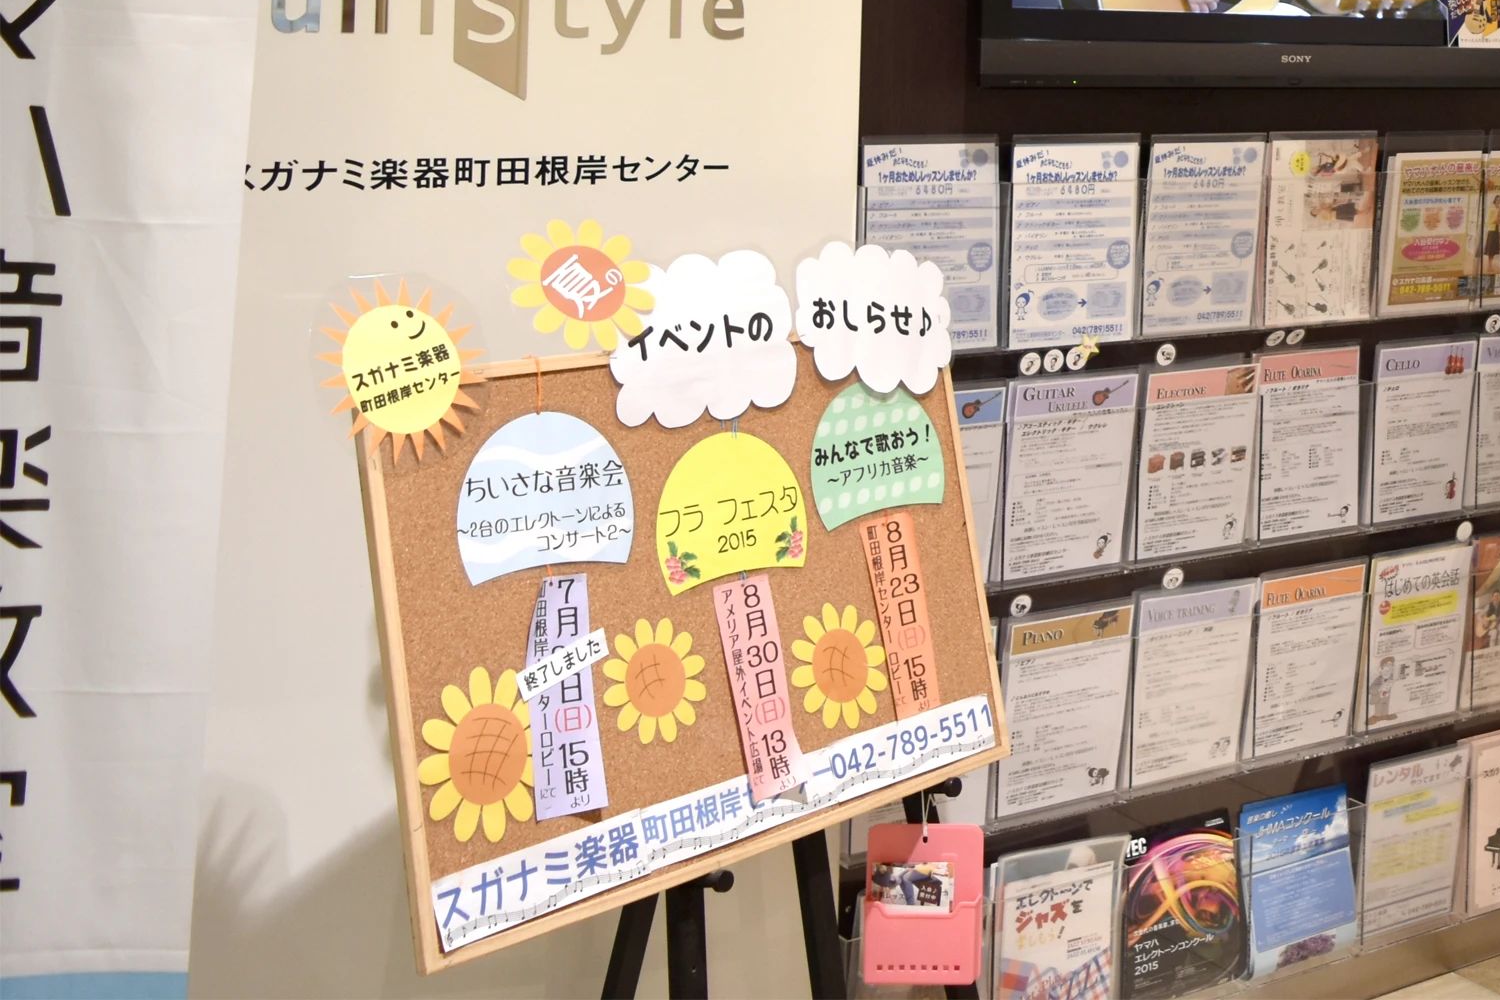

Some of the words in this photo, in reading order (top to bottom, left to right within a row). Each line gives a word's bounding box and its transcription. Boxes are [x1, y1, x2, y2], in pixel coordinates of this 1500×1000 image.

[1281, 55, 1312, 64] SONY
[628, 312, 774, 361] イベントの
[351, 343, 451, 392] スガナミ楽器
[1264, 367, 1286, 382] FLUTE
[1385, 358, 1421, 372] CELLO
[359, 370, 461, 414] 町田根岸センター
[1022, 386, 1076, 402] GUITAR
[1156, 386, 1208, 400] ELECTONE
[465, 459, 624, 503] ちいさな音楽会
[717, 529, 758, 554] 2015
[1022, 627, 1064, 646] PIANO
[522, 638, 602, 693] 終了しました
[1373, 766, 1424, 788] レンタル
[437, 821, 639, 929] スガナミ楽器
[830, 702, 993, 780] 042-789-5511
[1134, 938, 1159, 953] ヤマハ
[1134, 933, 1216, 965] エレクトーンコンクール
[1134, 962, 1159, 976] 2015
